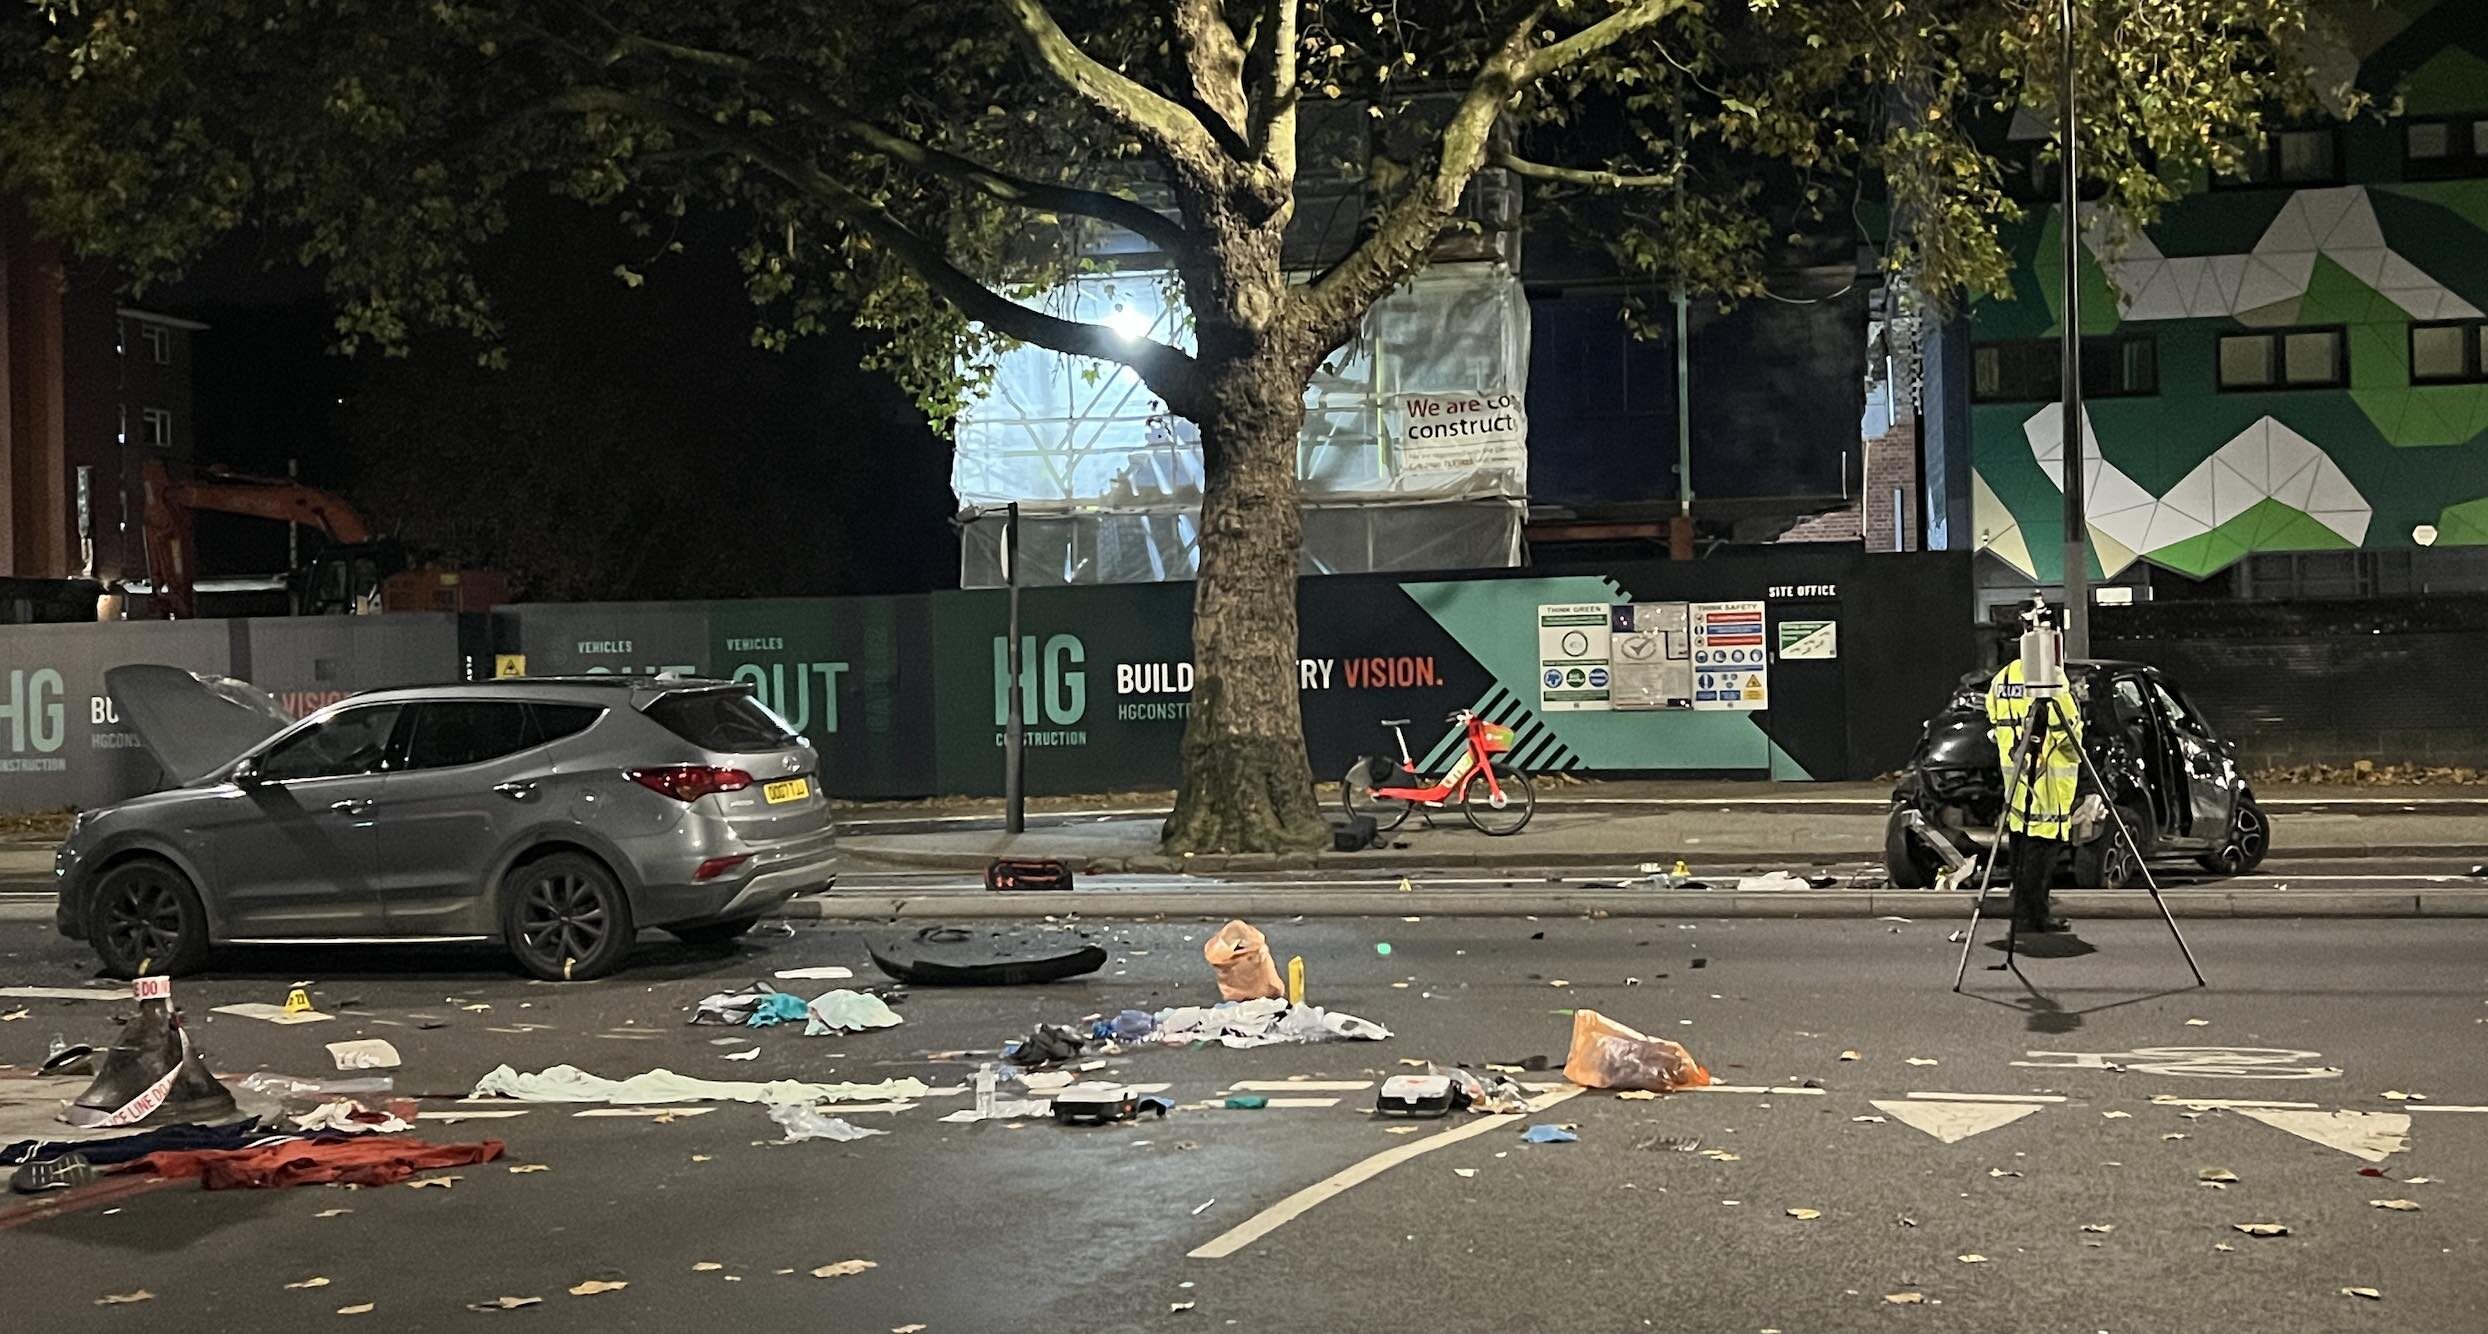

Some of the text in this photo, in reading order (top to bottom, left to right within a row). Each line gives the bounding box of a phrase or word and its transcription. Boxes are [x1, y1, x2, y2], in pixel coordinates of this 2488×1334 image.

[1407, 399, 1440, 418] We
[1446, 399, 1481, 415] are
[1409, 415, 1513, 440] construct
[1768, 584, 1837, 598] SITE OFFICE
[577, 641, 633, 654] VEHICLES
[726, 638, 784, 652] VEHICLES
[994, 634, 1086, 726] HG
[1117, 657, 1443, 694] BUILD RY VISION.
[996, 731, 1087, 747] CTRUCTION
